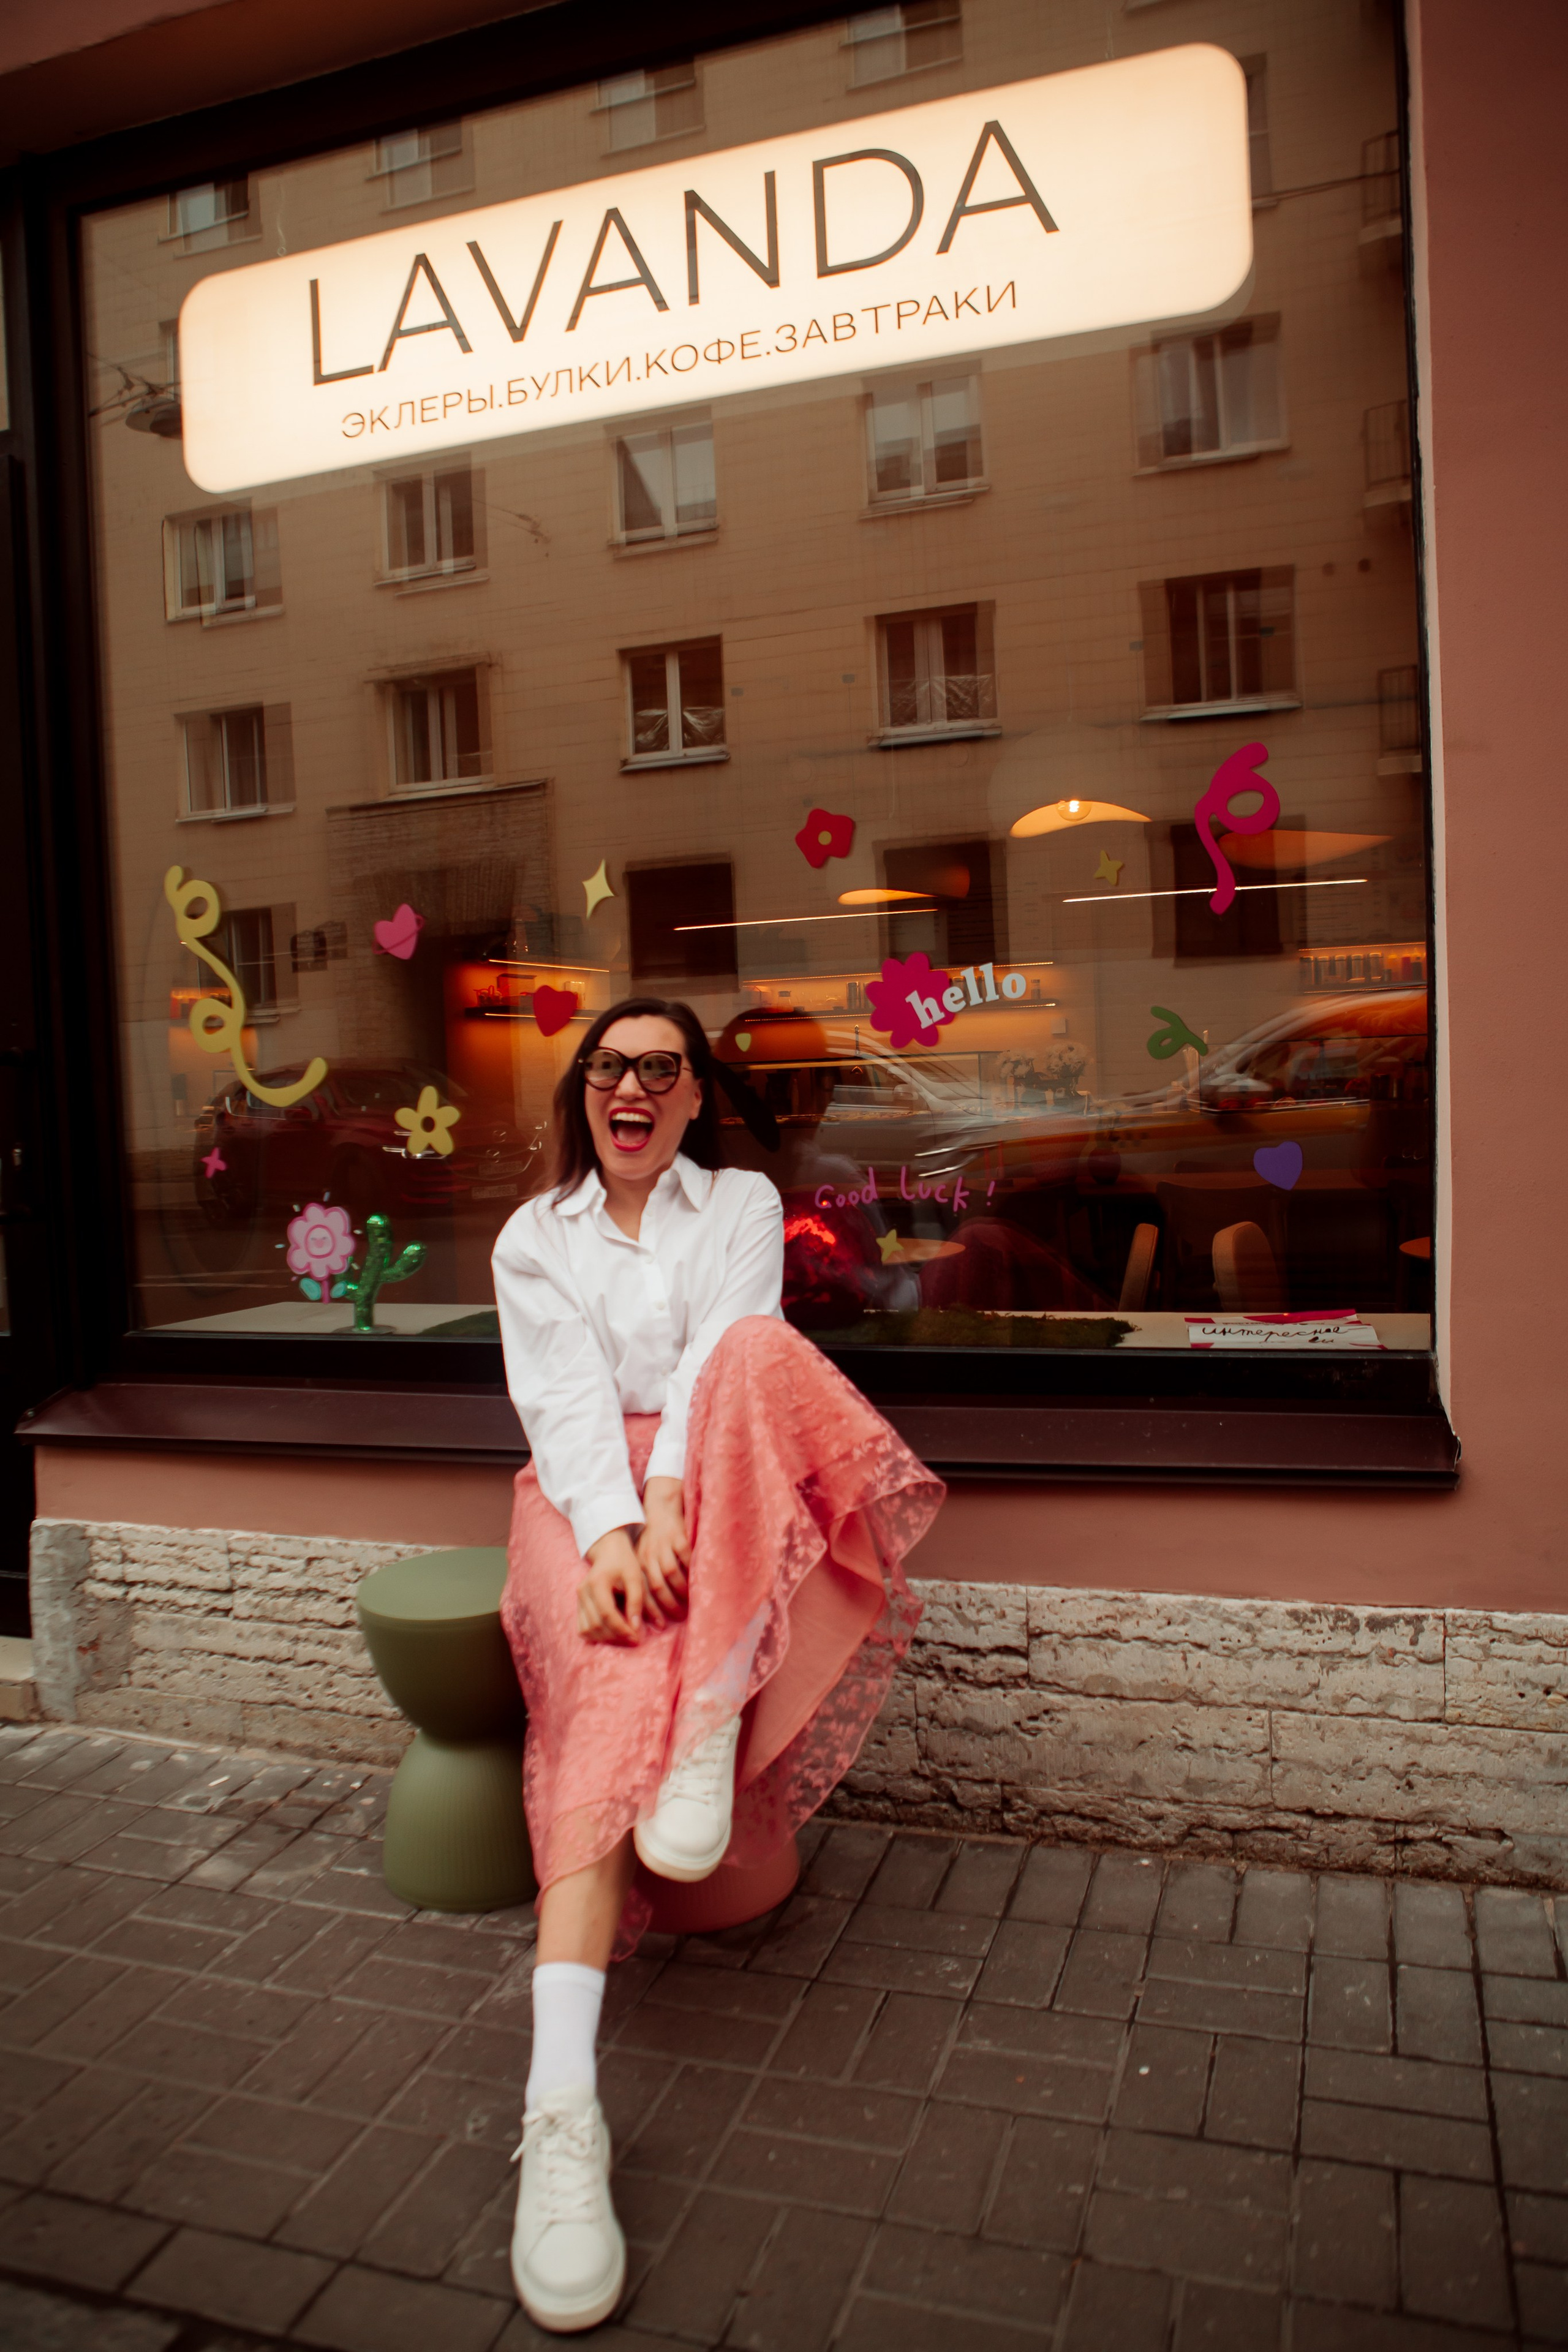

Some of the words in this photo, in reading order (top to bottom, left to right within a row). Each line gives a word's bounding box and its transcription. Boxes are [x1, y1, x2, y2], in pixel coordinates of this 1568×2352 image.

[310, 119, 1059, 385] LAVANDA
[905, 962, 1026, 1029] hello
[815, 1166, 878, 1209] Good
